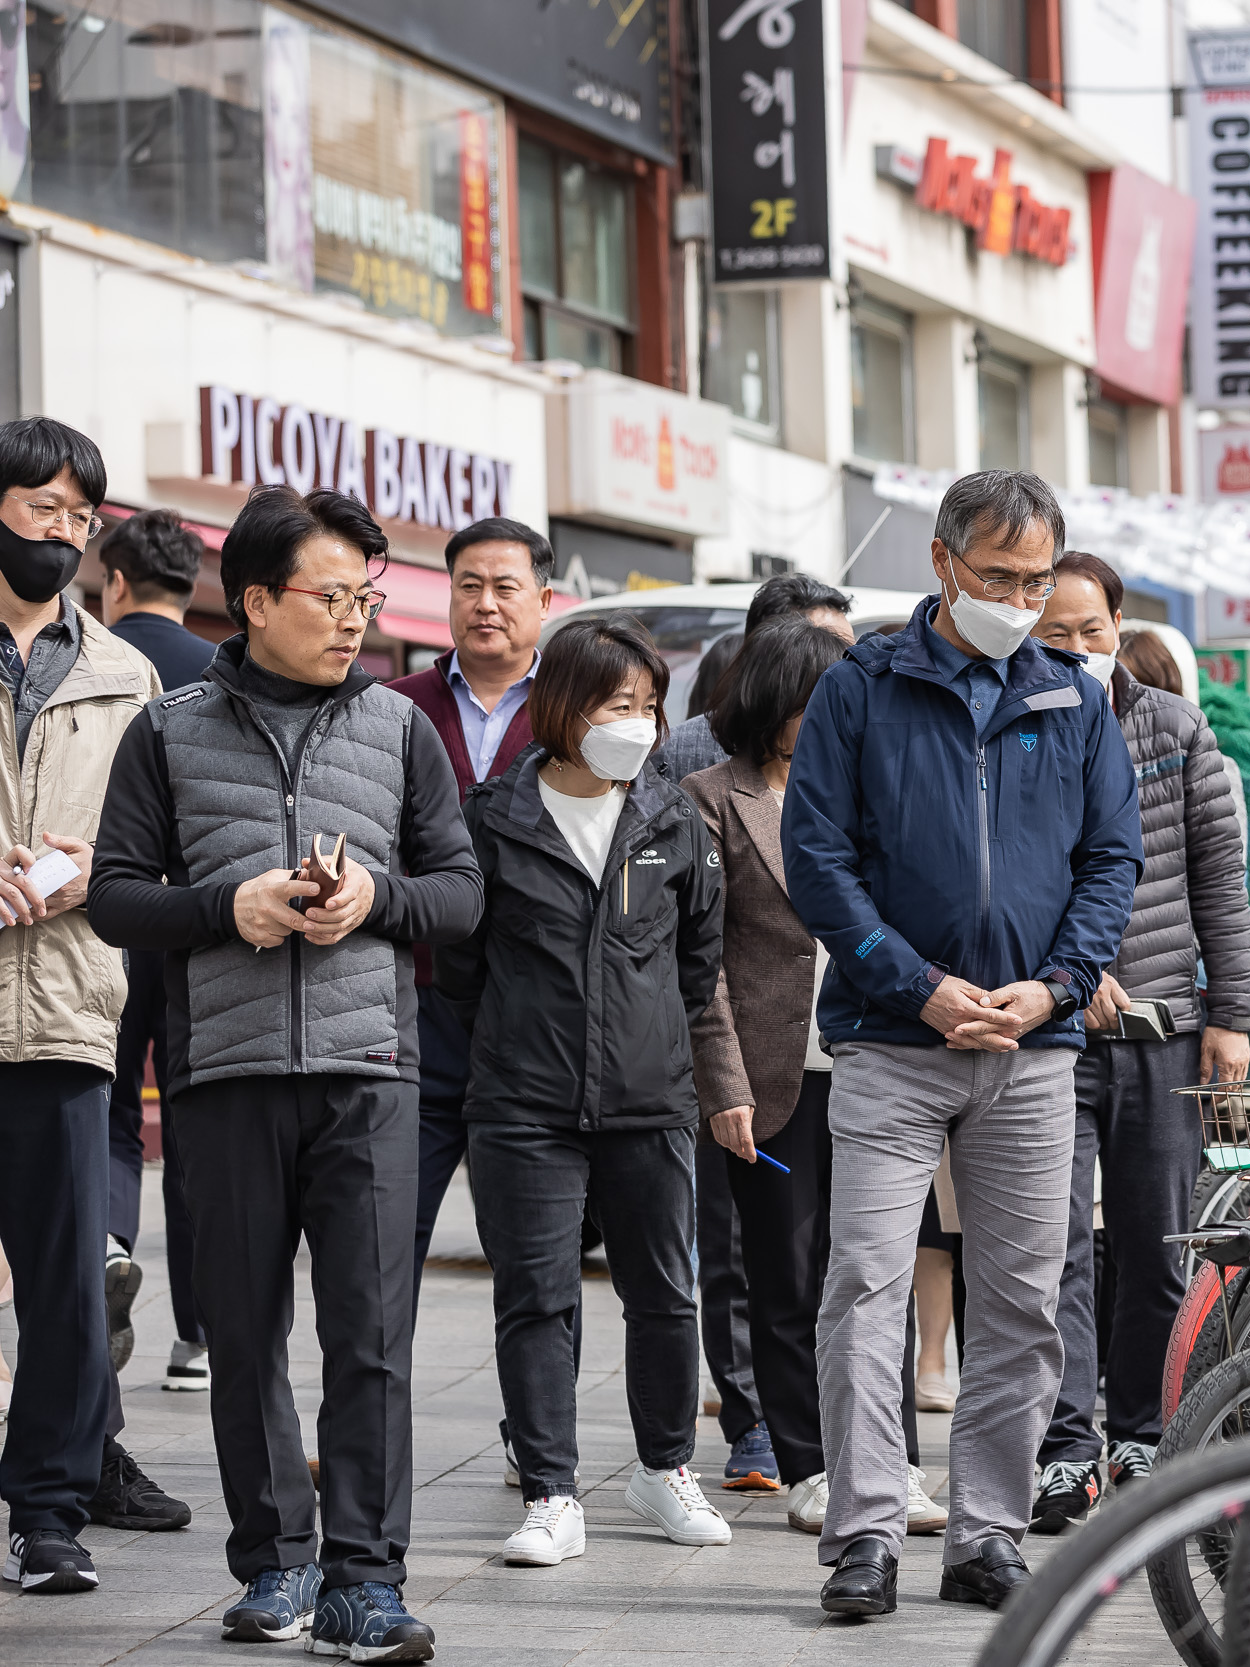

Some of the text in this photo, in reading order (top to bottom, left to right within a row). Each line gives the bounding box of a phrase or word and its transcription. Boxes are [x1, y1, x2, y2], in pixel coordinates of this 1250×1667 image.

[750, 198, 796, 239] 2F
[203, 385, 369, 507] PICOYA
[366, 428, 514, 531] BAKERY
[163, 689, 204, 708] hummel
